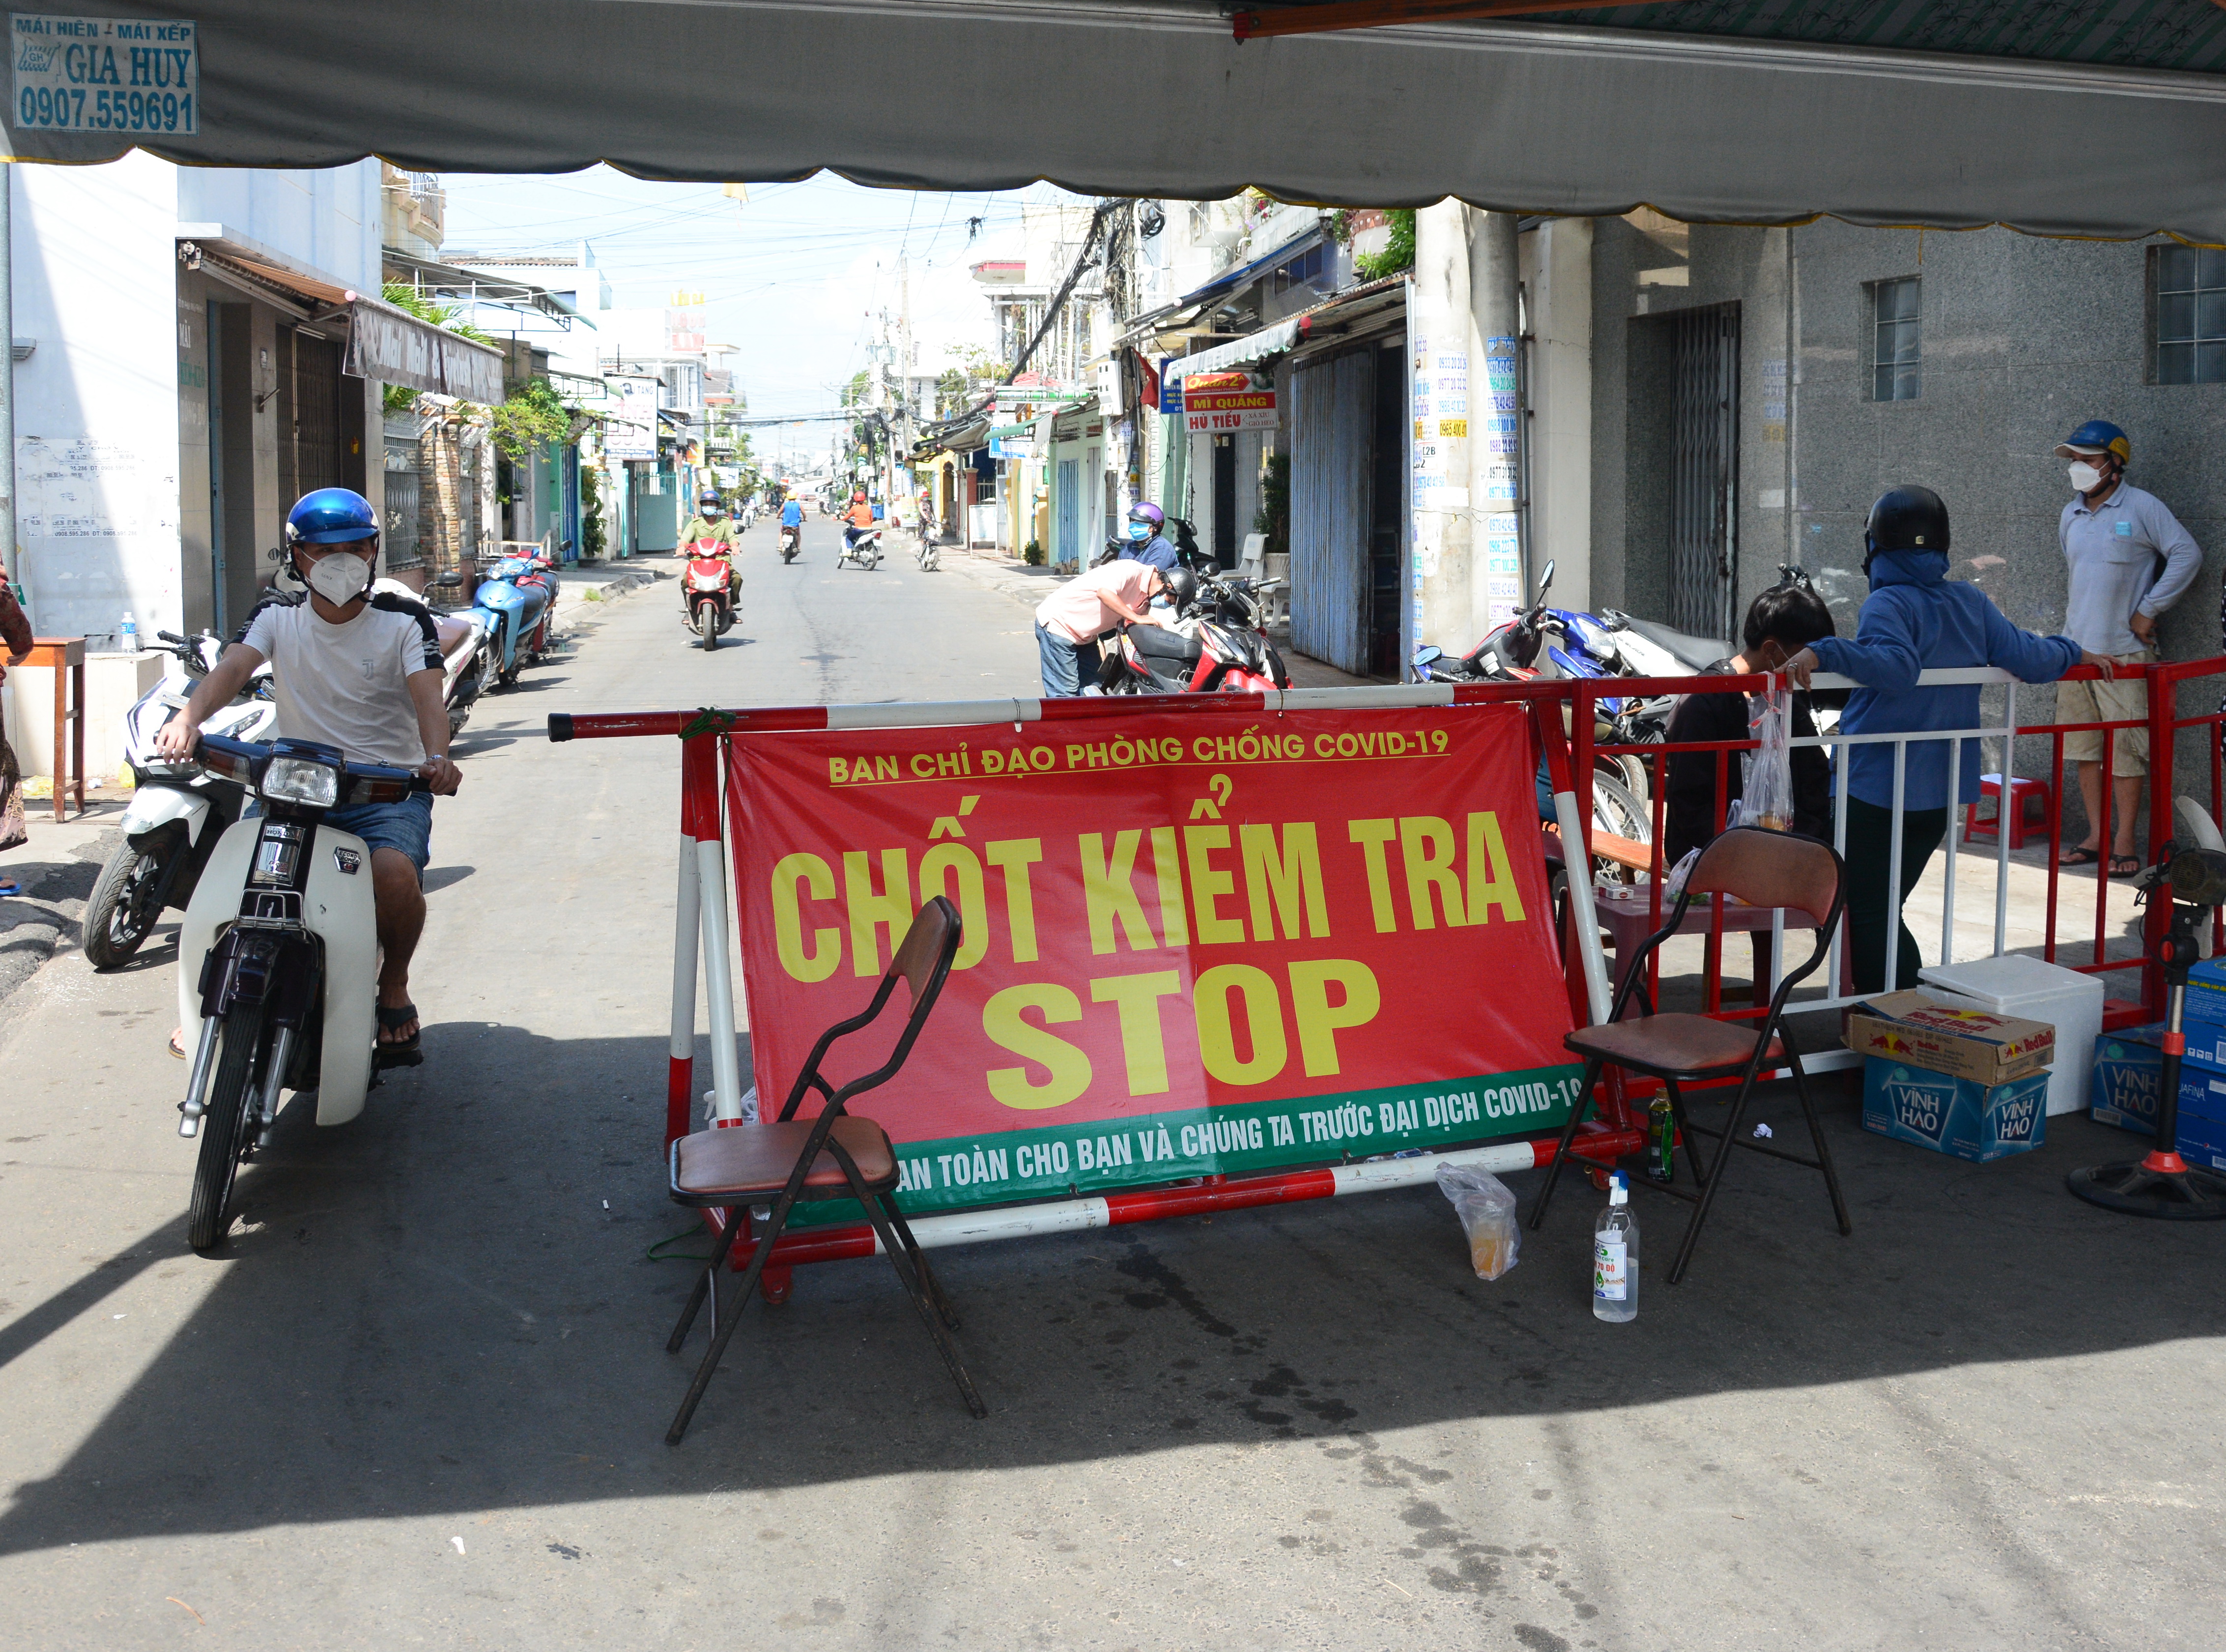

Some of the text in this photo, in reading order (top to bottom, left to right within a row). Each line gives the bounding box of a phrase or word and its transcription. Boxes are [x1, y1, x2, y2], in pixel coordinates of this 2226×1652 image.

[17, 18, 49, 34] MÁI
[57, 20, 98, 37] HIÊN
[117, 23, 151, 40] MÁI
[157, 23, 191, 41] XẾP
[29, 53, 43, 62] GH
[65, 43, 192, 88] GIA HUY
[21, 86, 192, 132] 0907.559691
[1188, 377, 1228, 389] Quán
[1194, 395, 1267, 409] MÌ QUẢNG
[1212, 410, 1241, 428] TIẾU
[829, 725, 1449, 783] BAN CHỈ ĐẠO PHÒNG CHỐNG COVID-19
[771, 774, 1527, 983] CHỐT KIỂM TRA
[1906, 1012, 1953, 1024] Red
[1945, 1020, 1992, 1032] Bull
[983, 959, 1381, 1110] STOP
[2023, 1030, 2053, 1053] Red Bull
[2112, 1065, 2159, 1095] VĨNH
[1899, 1086, 1940, 1114] VĨNH
[2002, 1098, 2033, 1121] VĨNH
[896, 1157, 930, 1193] AN
[938, 1144, 1009, 1187] TOÀN
[1016, 1140, 1069, 1178] CHO
[1078, 1133, 1132, 1175] BẠN
[1139, 1122, 1174, 1161] VÀ
[1180, 1115, 1262, 1157] CHÚNG
[1268, 1114, 1295, 1146] TA
[1303, 1101, 1374, 1142] TRƯỚC
[1380, 1099, 1419, 1137] ĐẠI
[1427, 1091, 1480, 1132] DỊCH
[1598, 1262, 1604, 1271] 70
